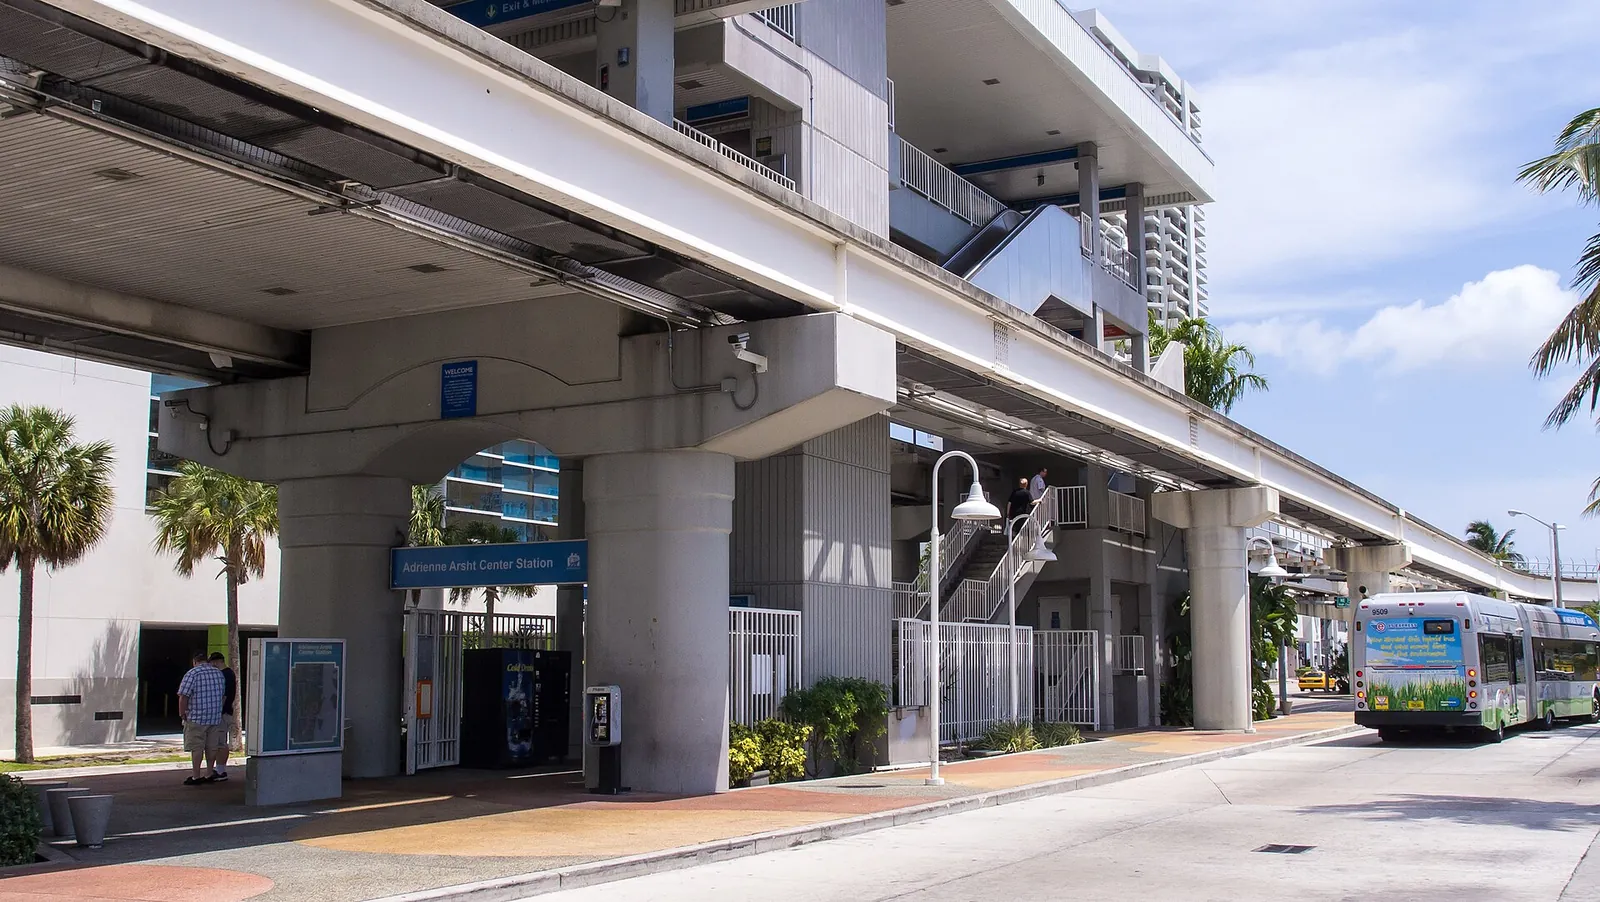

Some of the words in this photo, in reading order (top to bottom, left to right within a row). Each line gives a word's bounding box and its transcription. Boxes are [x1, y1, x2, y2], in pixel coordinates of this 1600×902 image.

[503, 1, 520, 13] Exit
[444, 366, 473, 375] WELCOME
[402, 562, 446, 573] Adrienne
[449, 560, 476, 571] Arsht
[480, 559, 514, 570] Center
[516, 557, 553, 569] Station
